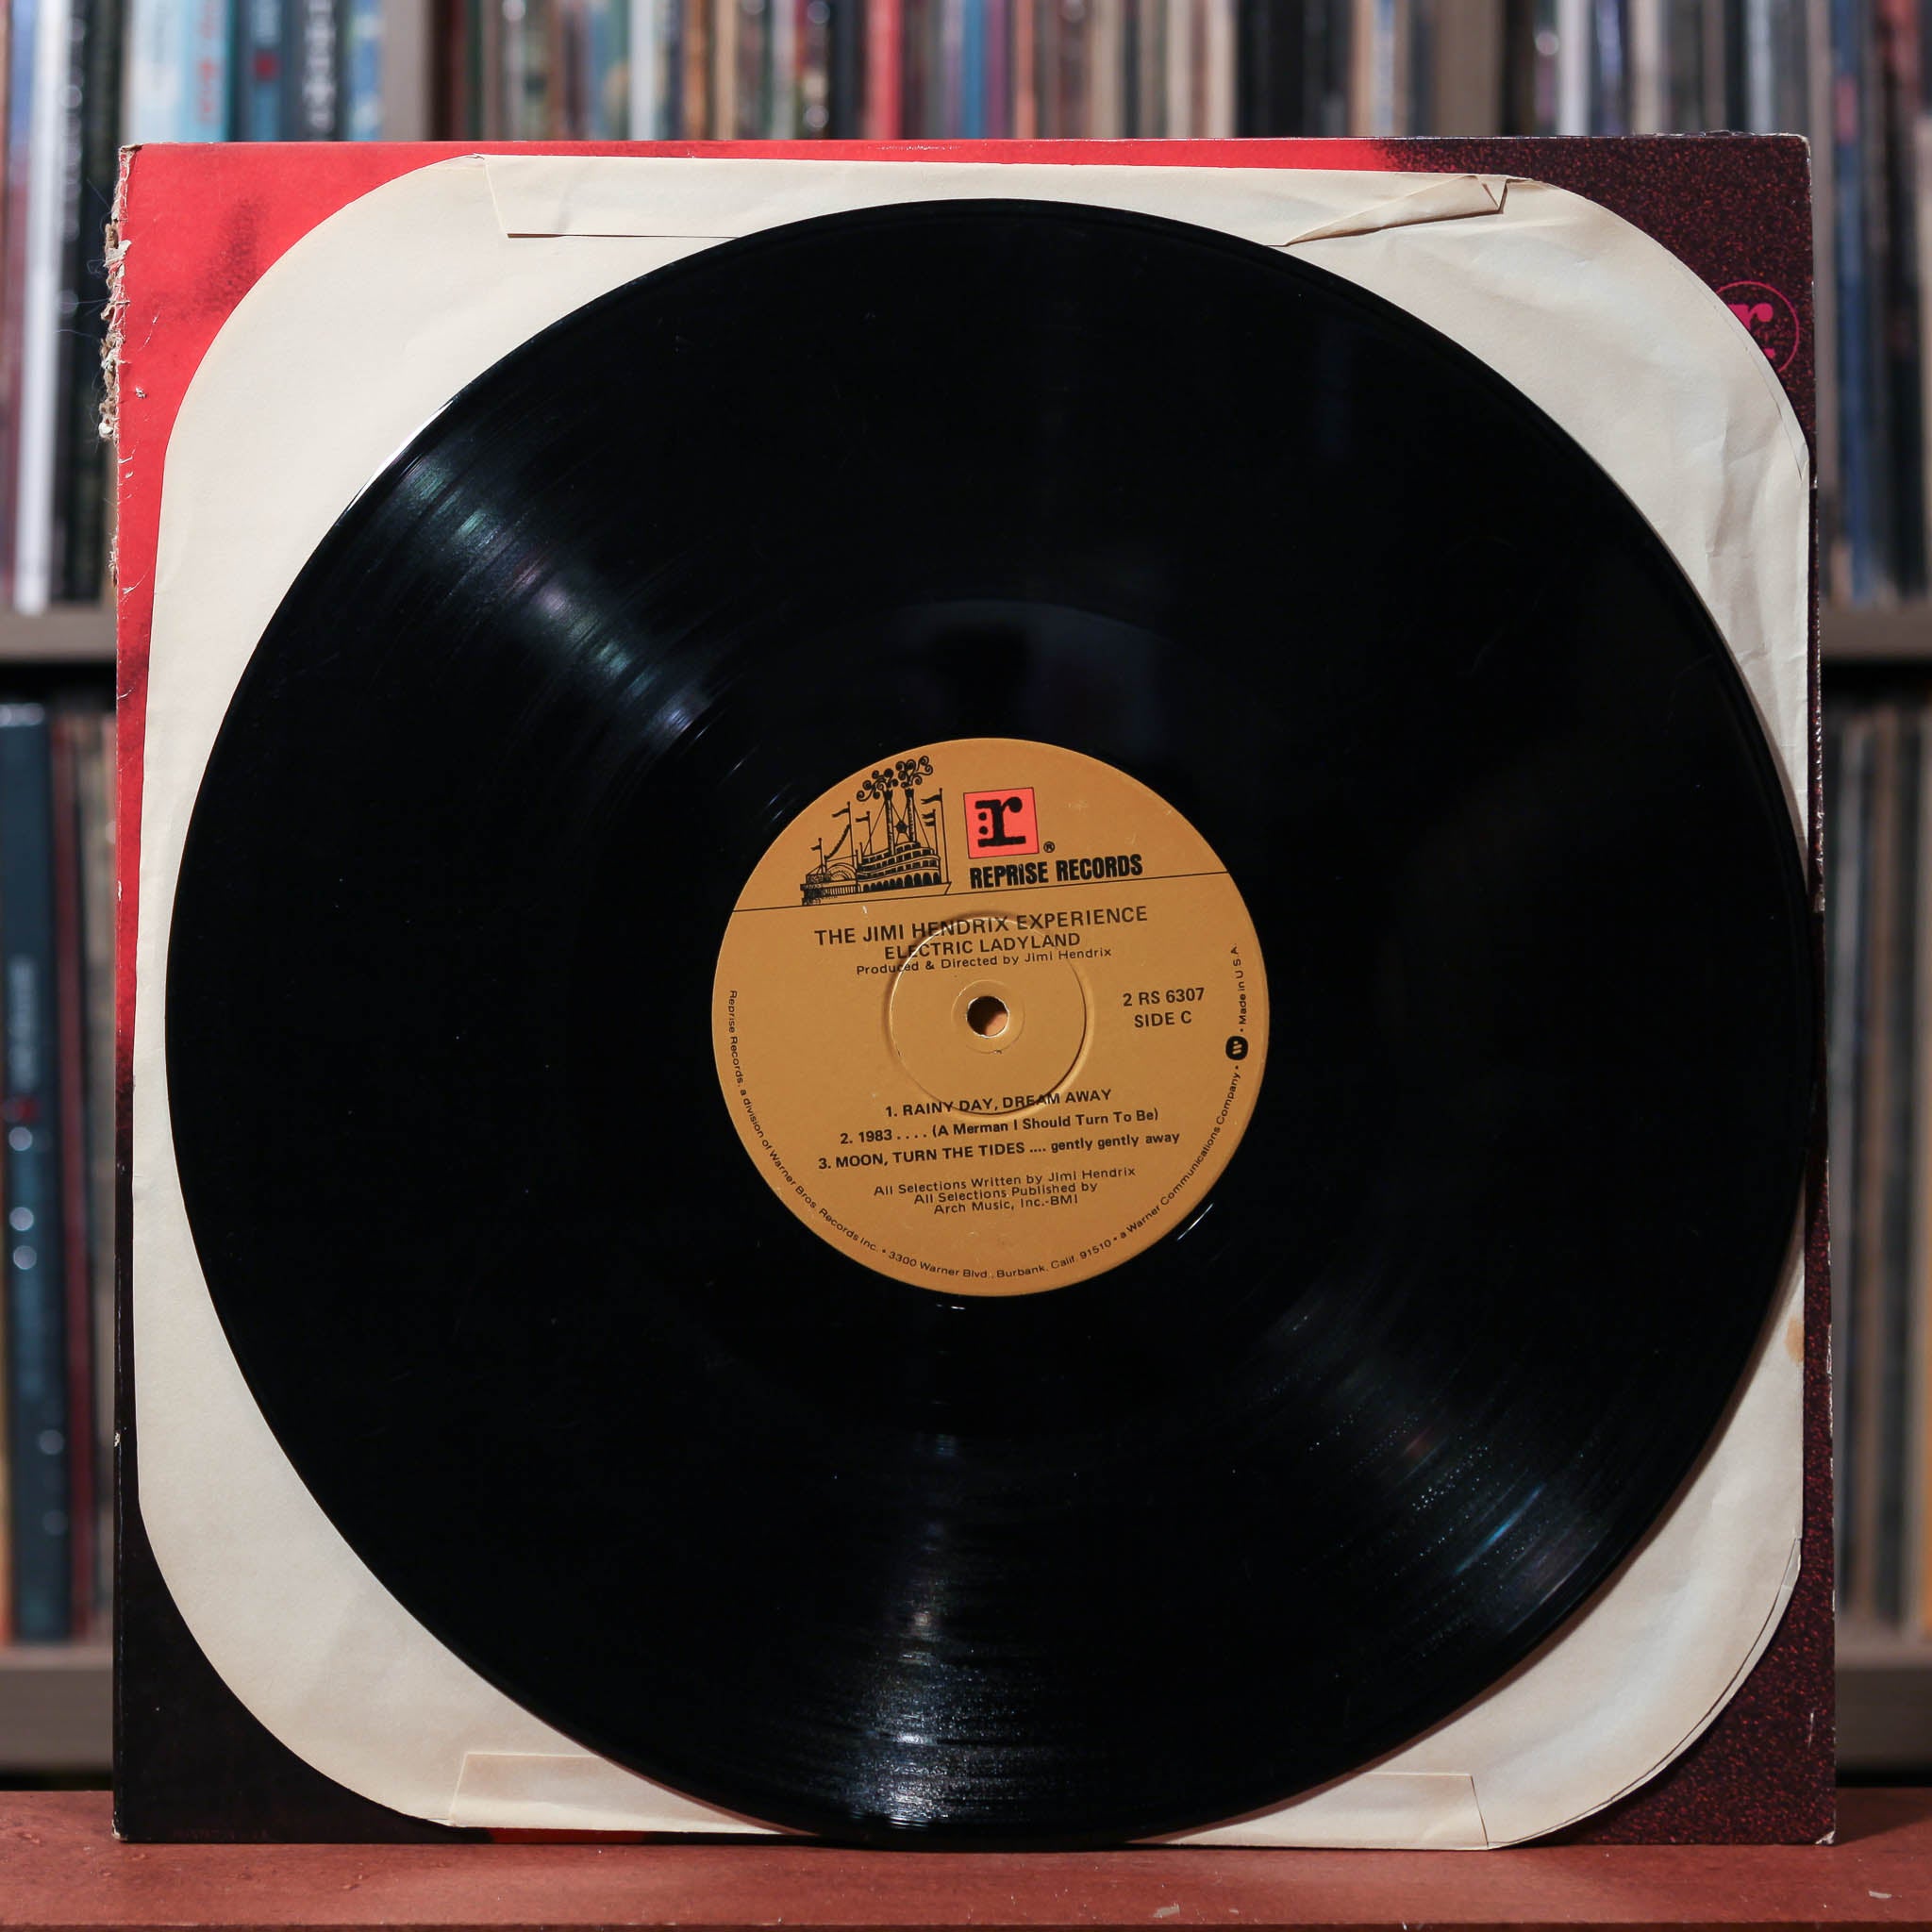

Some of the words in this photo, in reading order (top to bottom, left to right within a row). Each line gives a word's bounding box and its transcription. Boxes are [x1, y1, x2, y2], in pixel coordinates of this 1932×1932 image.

[970, 861, 1049, 889] REPRISE
[1056, 854, 1142, 882] RECORDS
[815, 927, 856, 945] THE
[863, 924, 904, 941] JIMI
[912, 917, 1008, 939] HENDRIX
[1016, 906, 1147, 929] EXPERIENCE
[857, 962, 919, 974] Produced
[941, 956, 997, 969] Directed
[1003, 954, 1019, 966] by
[1024, 950, 1053, 962] Jimi
[1058, 947, 1111, 960] Hendrix
[885, 941, 973, 960] ELECTRIC
[980, 933, 1080, 953] LADYLAND
[1123, 993, 1132, 1007] 2
[1139, 991, 1160, 1005] RS
[1165, 987, 1205, 1004] 6307
[1134, 1012, 1174, 1028] SIDE
[1181, 1010, 1192, 1024] C
[886, 1106, 897, 1117] 1.
[903, 1101, 954, 1116] RAINY
[959, 1098, 998, 1111] DAY,
[1003, 1093, 1059, 1108] DREAM
[1065, 1089, 1111, 1103] AWAY
[728, 991, 738, 1033] Reprise
[743, 1098, 764, 1138] division
[761, 1140, 773, 1151] of
[769, 1151, 796, 1186] Warner
[819, 1208, 859, 1241] Records
[889, 1251, 917, 1268] 3300
[920, 1260, 959, 1276] Warner
[1079, 1239, 1111, 1259] 91510
[1120, 1231, 1126, 1240] a
[1126, 1205, 1160, 1233] Warner
[1159, 1126, 1221, 1206] Communications
[1216, 1073, 1241, 1124] Company
[1238, 981, 1245, 991] in
[841, 1132, 853, 1144] 2.
[858, 1129, 892, 1143] 1983
[932, 1124, 949, 1138] (A
[953, 1121, 1008, 1136] Merman
[1013, 1119, 1018, 1130] I
[1023, 1115, 1071, 1130] Should
[1075, 1114, 1108, 1125] Turn
[1113, 1111, 1132, 1124] To
[1136, 1108, 1158, 1121] Be)
[818, 1158, 831, 1169] 3.
[836, 1153, 889, 1168] MOON,
[892, 1149, 937, 1163] TURN
[942, 1146, 974, 1158] THE
[978, 1141, 1024, 1157] TIDES
[1051, 1138, 1092, 1153] gently
[1097, 1134, 1139, 1149] gently
[1145, 1133, 1179, 1144] away
[874, 1186, 893, 1196] All
[898, 1179, 966, 1194] Selections
[971, 1176, 1021, 1188] Written
[1026, 1174, 1042, 1185] by
[1049, 1171, 1076, 1182] Jimi
[1082, 1167, 1136, 1179] Hendrix
[914, 1193, 934, 1205] All
[938, 1189, 1007, 1203] Selections
[1011, 1182, 1076, 1196] Published
[1081, 1182, 1098, 1192] by
[934, 1203, 966, 1215] Arch
[972, 1200, 1014, 1211] Music,
